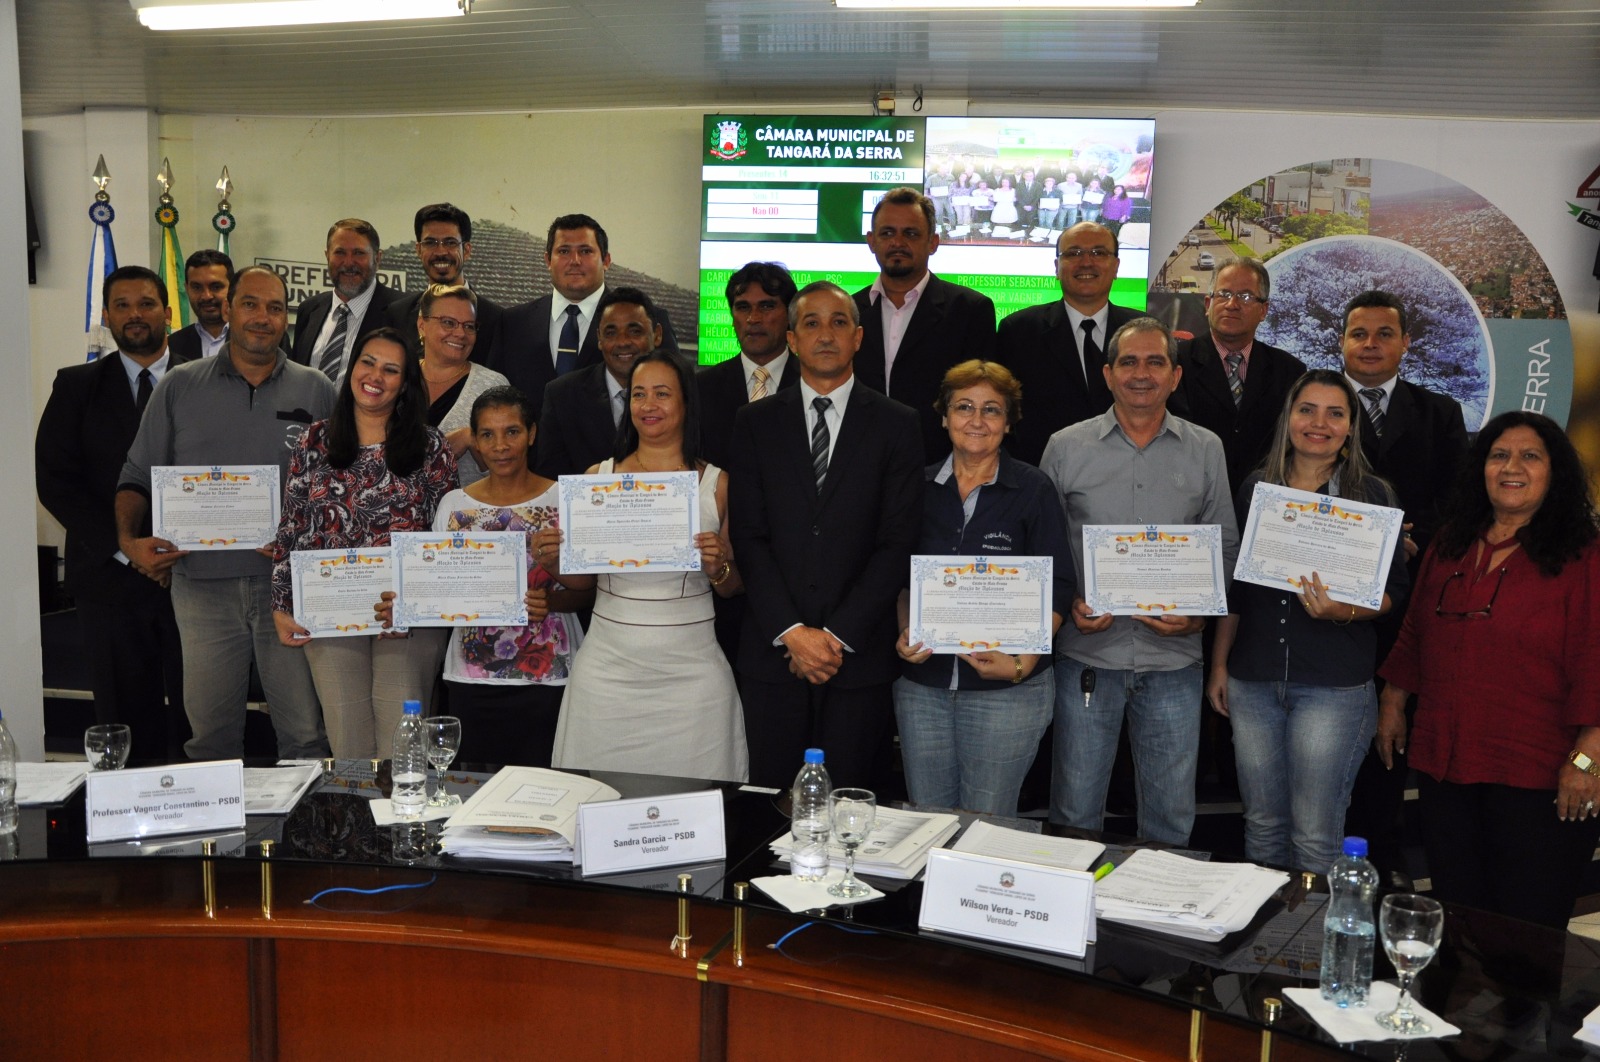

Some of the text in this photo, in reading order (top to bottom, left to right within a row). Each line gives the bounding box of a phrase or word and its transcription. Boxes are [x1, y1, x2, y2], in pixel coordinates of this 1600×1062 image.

[756, 125, 914, 142] CÂMARA MUNICIPAL DE
[767, 143, 902, 160] TANGARÁ DA SERRA
[958, 275, 1006, 287] PROFESSOR
[1009, 292, 1042, 302] VAGNER
[92, 806, 131, 817] Professor
[134, 804, 161, 814] Vagner
[164, 800, 209, 810] Constantino
[218, 796, 240, 805] PSDB
[154, 812, 183, 820] Vereador
[614, 838, 640, 848] Sandra
[642, 835, 666, 844] Garcia
[674, 831, 695, 841] PSDB
[641, 845, 669, 854] Vereador
[960, 898, 989, 911] Wilson
[991, 904, 1013, 915] Verta
[1024, 909, 1049, 922] PSDB
[986, 914, 1018, 927] Vereador
